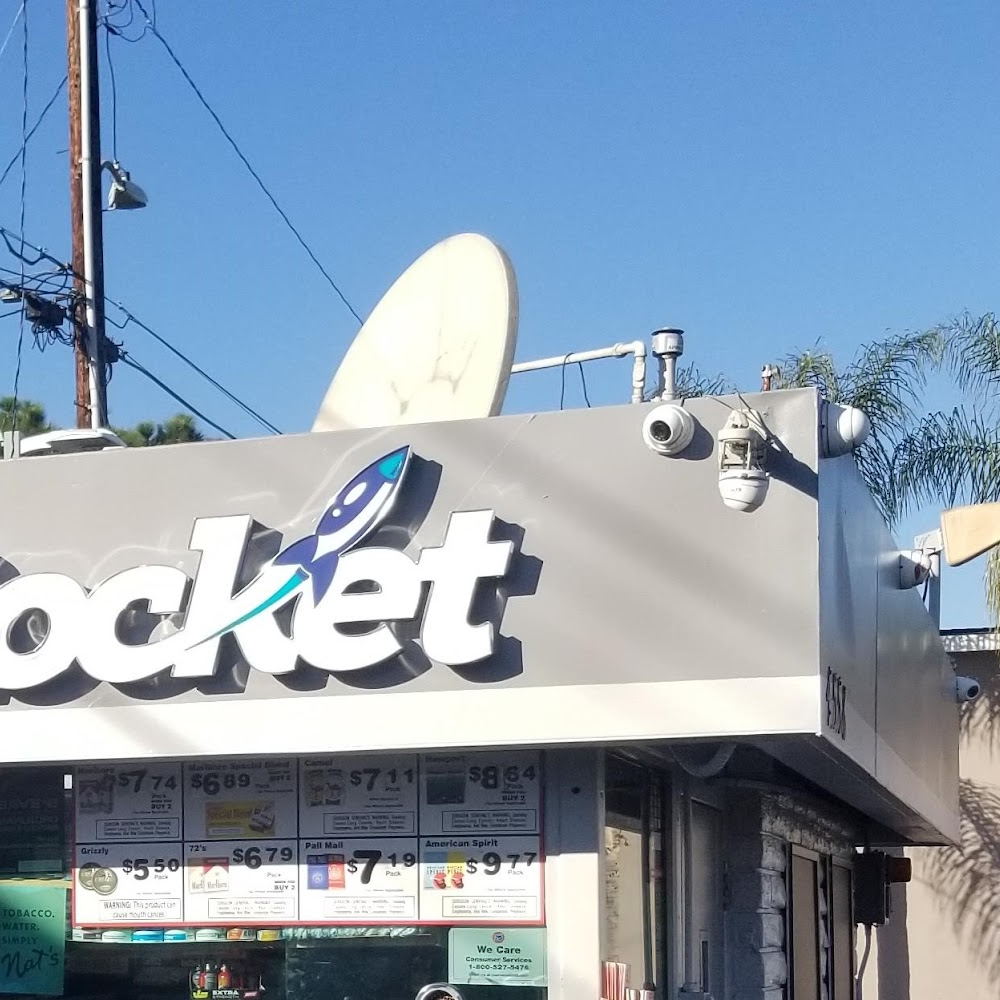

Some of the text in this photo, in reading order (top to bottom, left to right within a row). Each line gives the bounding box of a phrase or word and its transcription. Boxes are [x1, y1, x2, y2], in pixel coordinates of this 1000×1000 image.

[189, 844, 207, 852] 72's
[325, 841, 344, 849] Mall
[425, 839, 499, 849] American Spirit
[81, 847, 109, 856] Grizzly
[2, 909, 55, 918] TOBACCO.
[1, 922, 40, 932] WATER.
[1, 936, 38, 945] SIMPLY
[477, 945, 521, 954] We Care
[2, 946, 60, 979] Nat's
